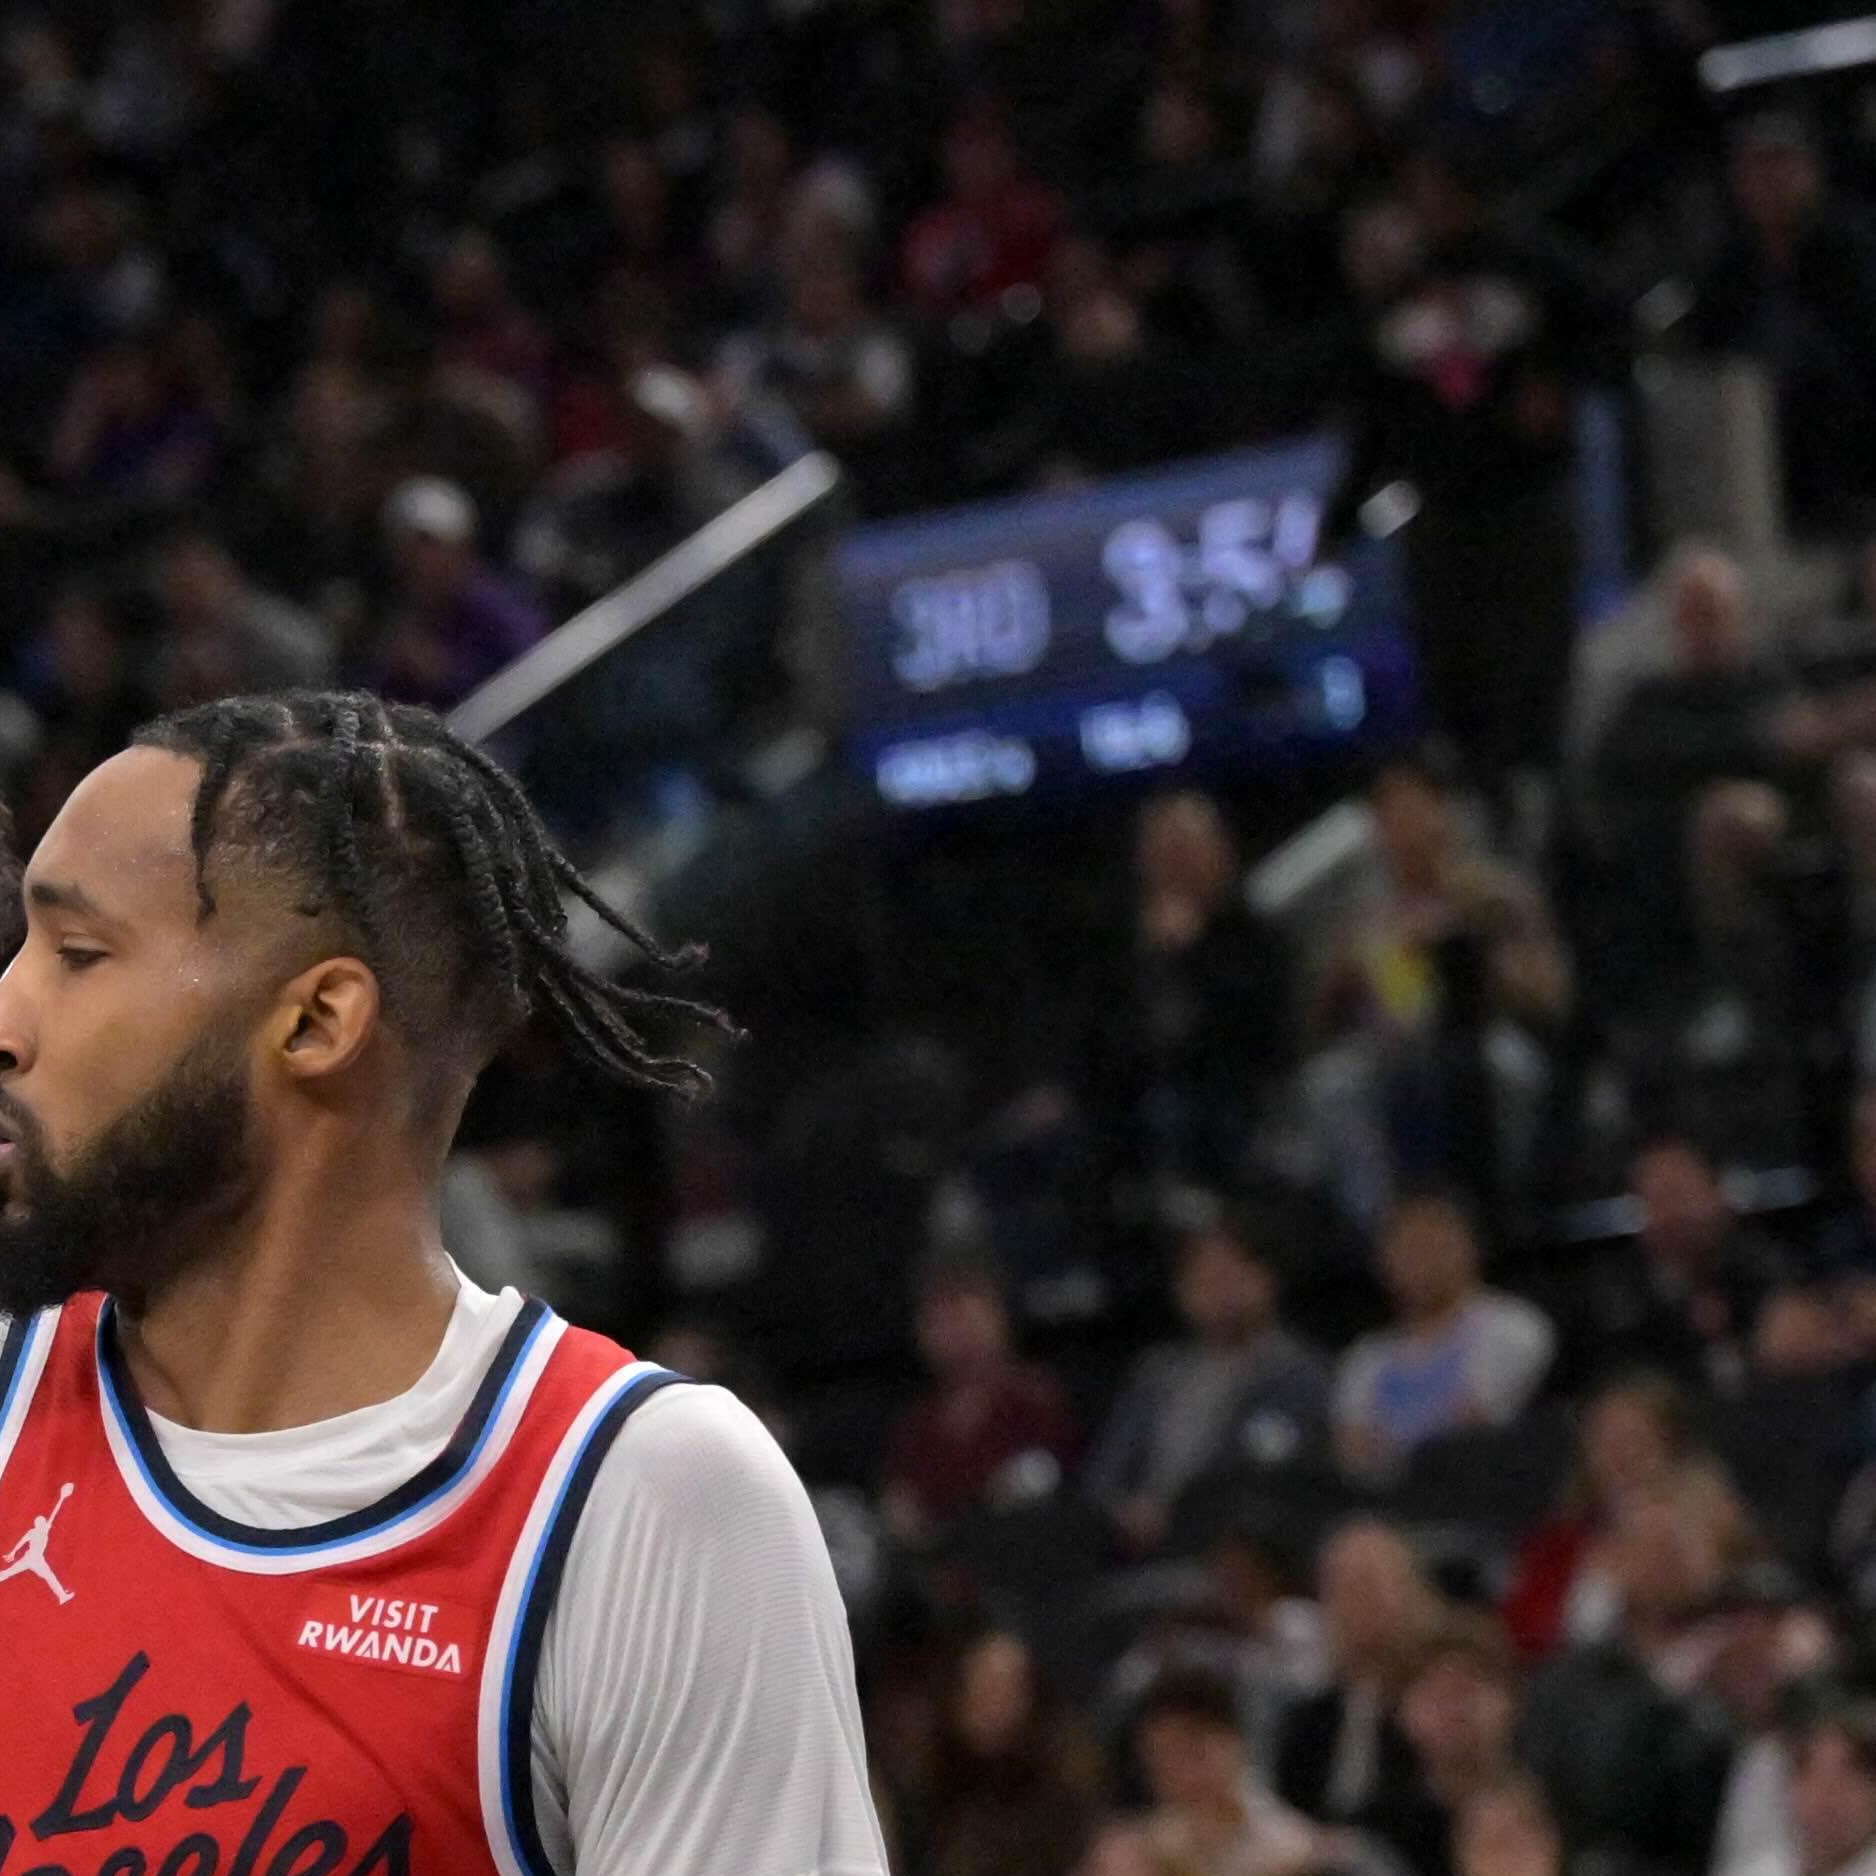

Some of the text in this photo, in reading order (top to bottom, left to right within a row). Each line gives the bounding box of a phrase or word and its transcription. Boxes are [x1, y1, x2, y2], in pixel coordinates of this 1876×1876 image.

[348, 1595, 439, 1635] VISIT
[297, 1620, 463, 1675] RWANDA
[31, 1650, 261, 1842] Los
